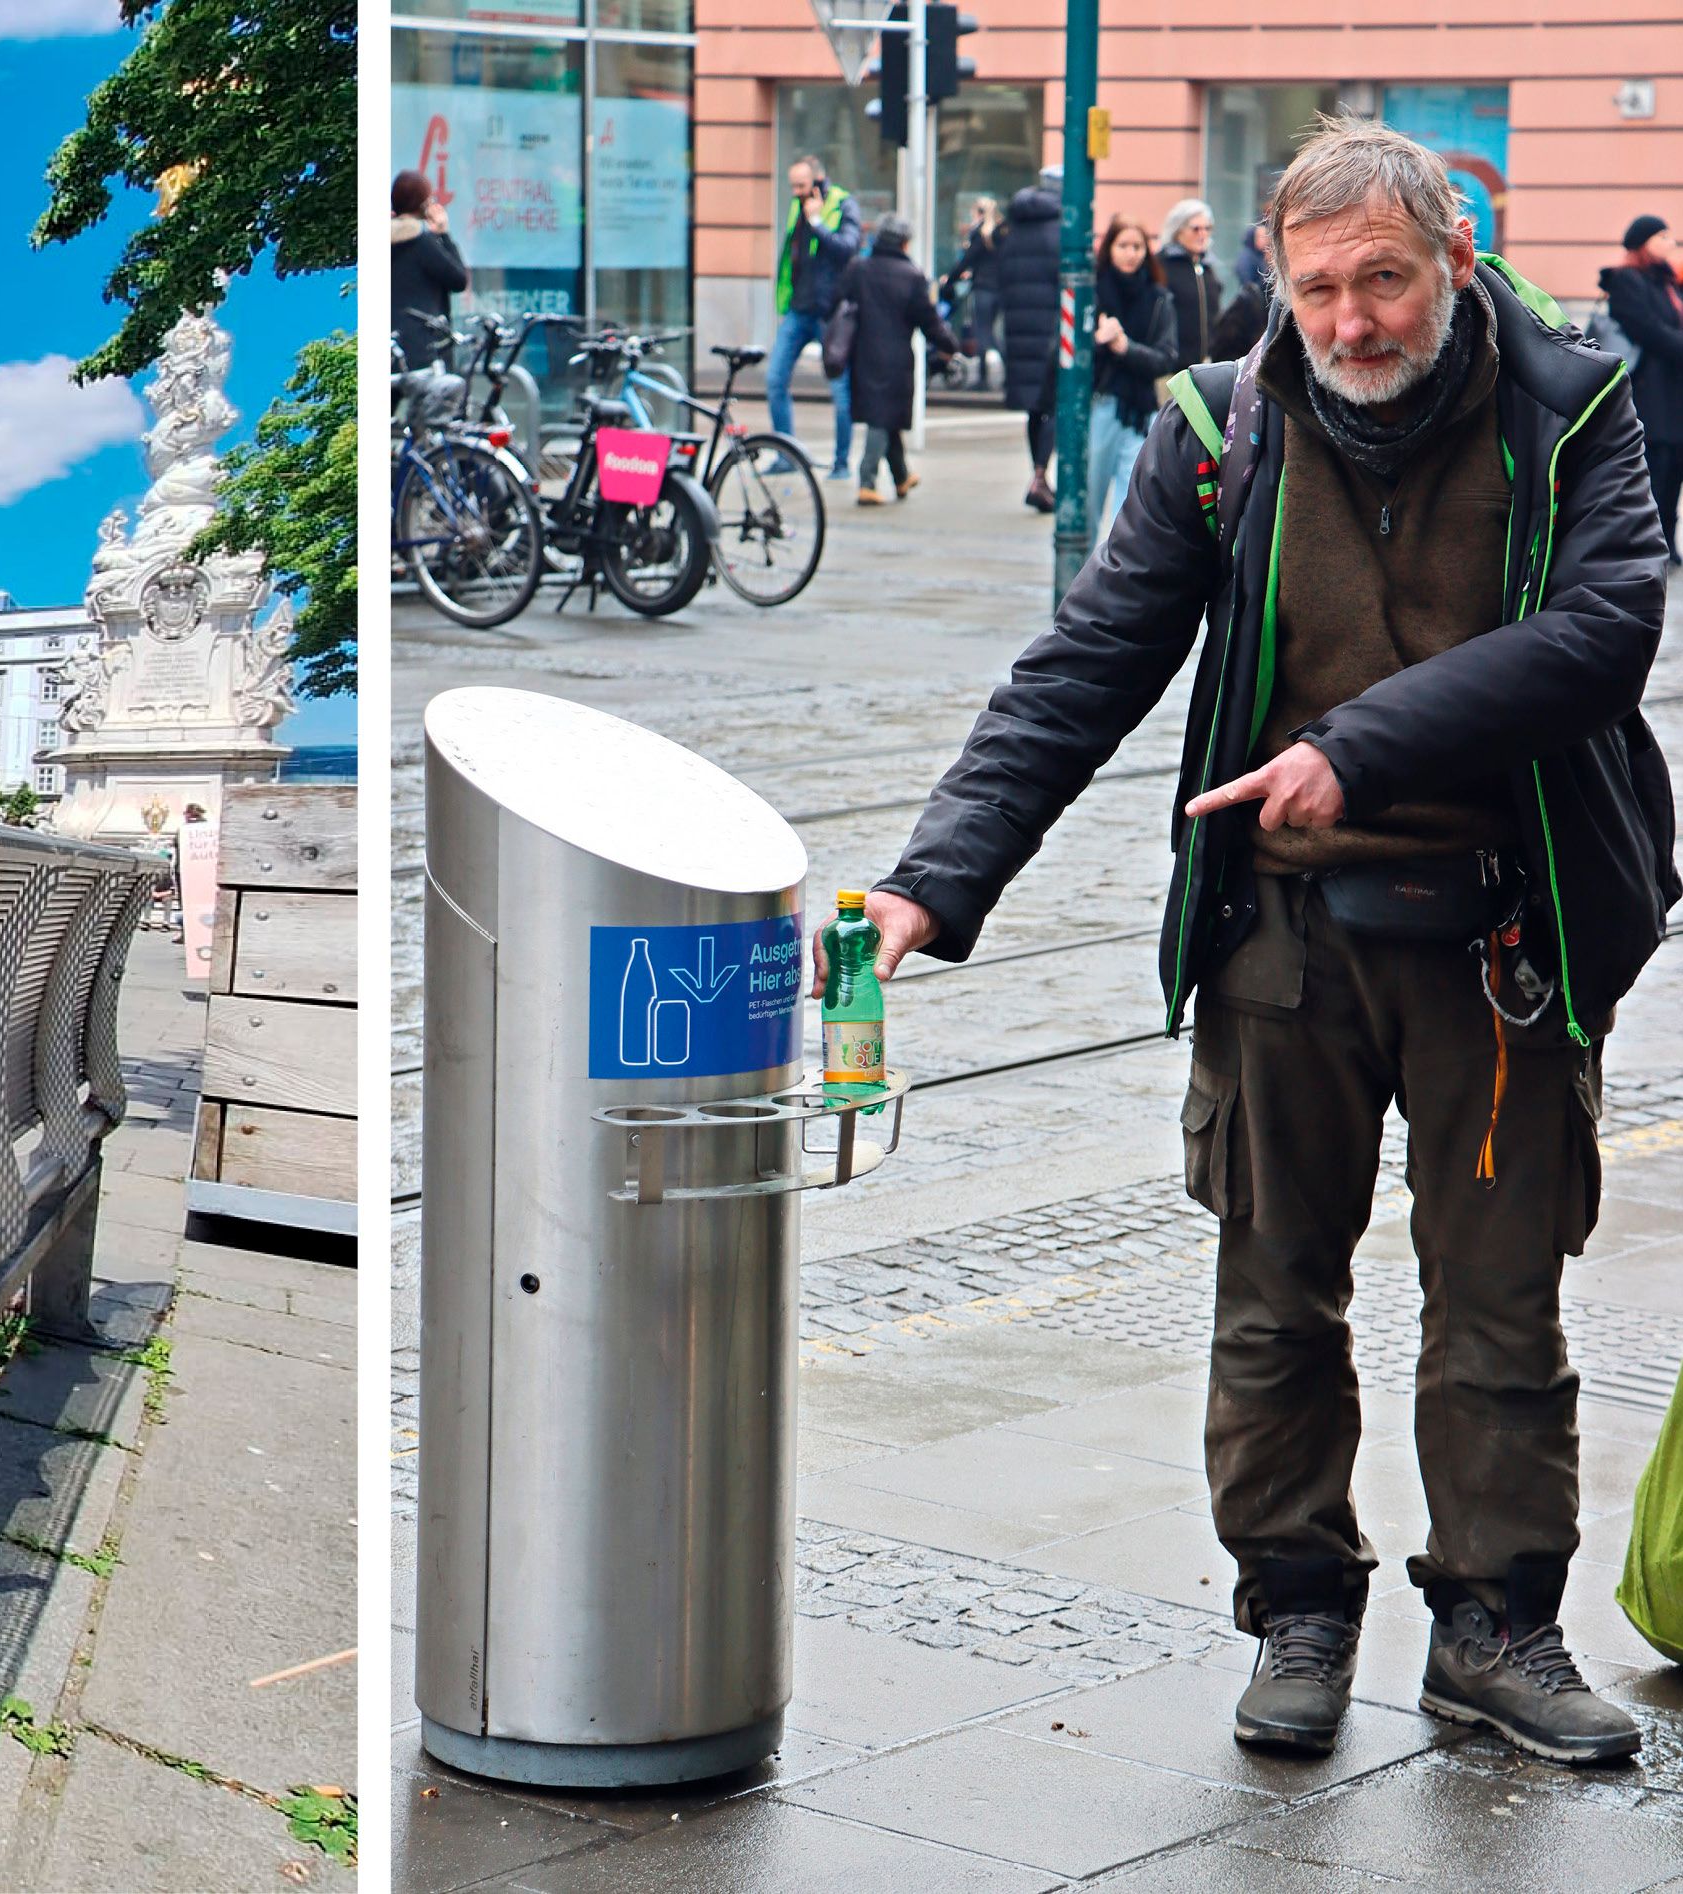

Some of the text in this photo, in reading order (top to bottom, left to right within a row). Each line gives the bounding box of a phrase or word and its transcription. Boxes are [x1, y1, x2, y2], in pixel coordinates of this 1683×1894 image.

[475, 177, 555, 204] CENTRAL
[470, 207, 560, 232] APOTHEKE
[750, 970, 782, 994] Hier
[469, 1648, 479, 1711] abfallhai
